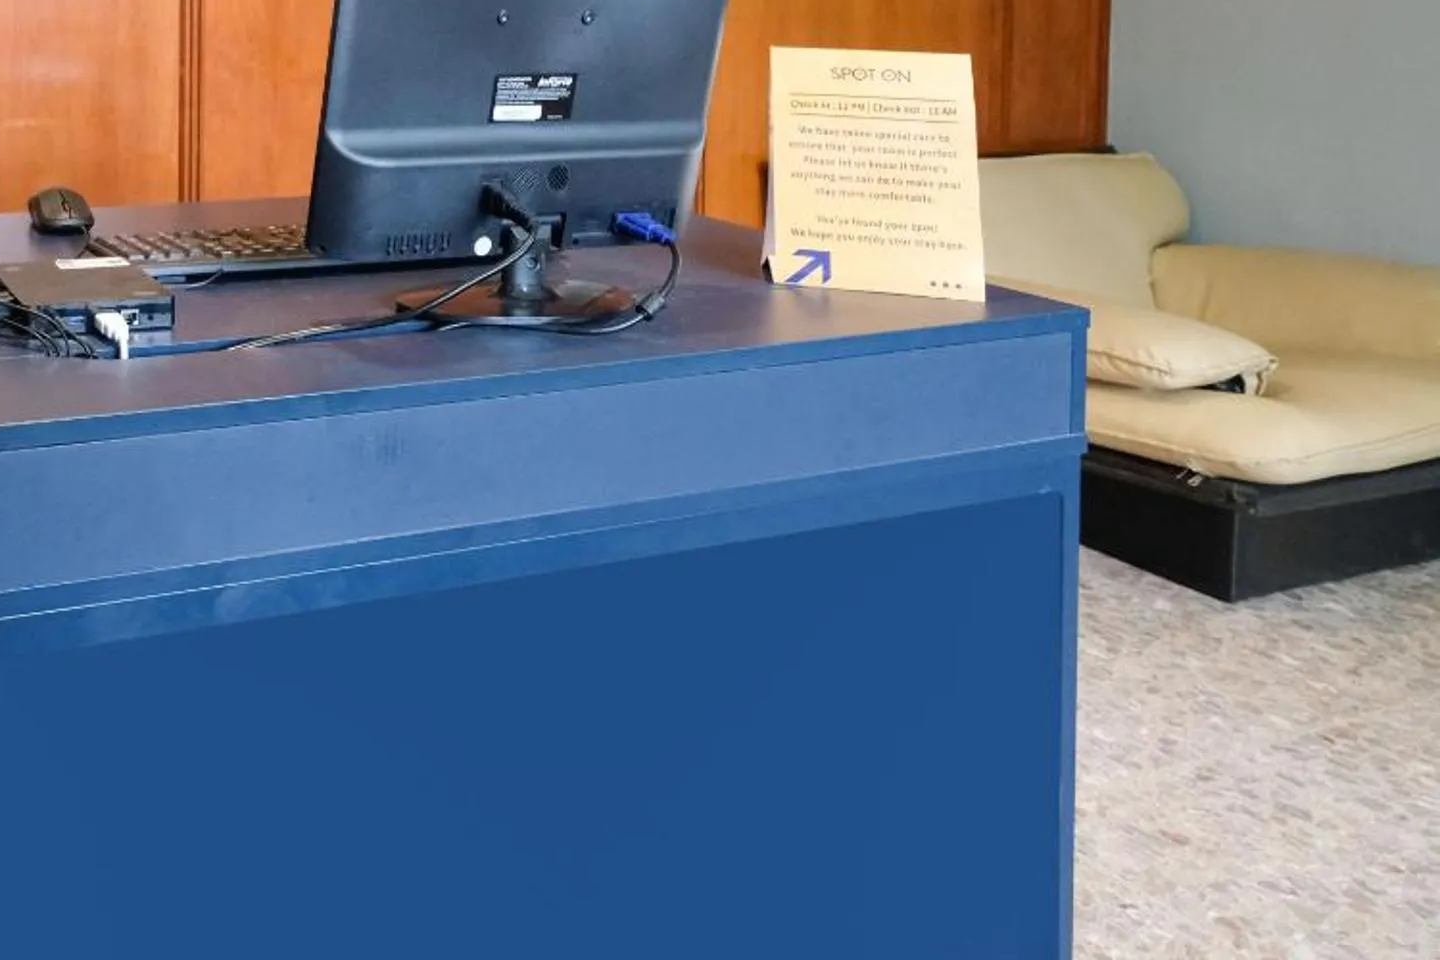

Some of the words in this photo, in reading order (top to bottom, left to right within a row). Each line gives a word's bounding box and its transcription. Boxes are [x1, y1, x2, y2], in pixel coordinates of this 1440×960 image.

[830, 66, 875, 81] SPOT
[881, 68, 911, 82] ON
[873, 103, 900, 113] Check
